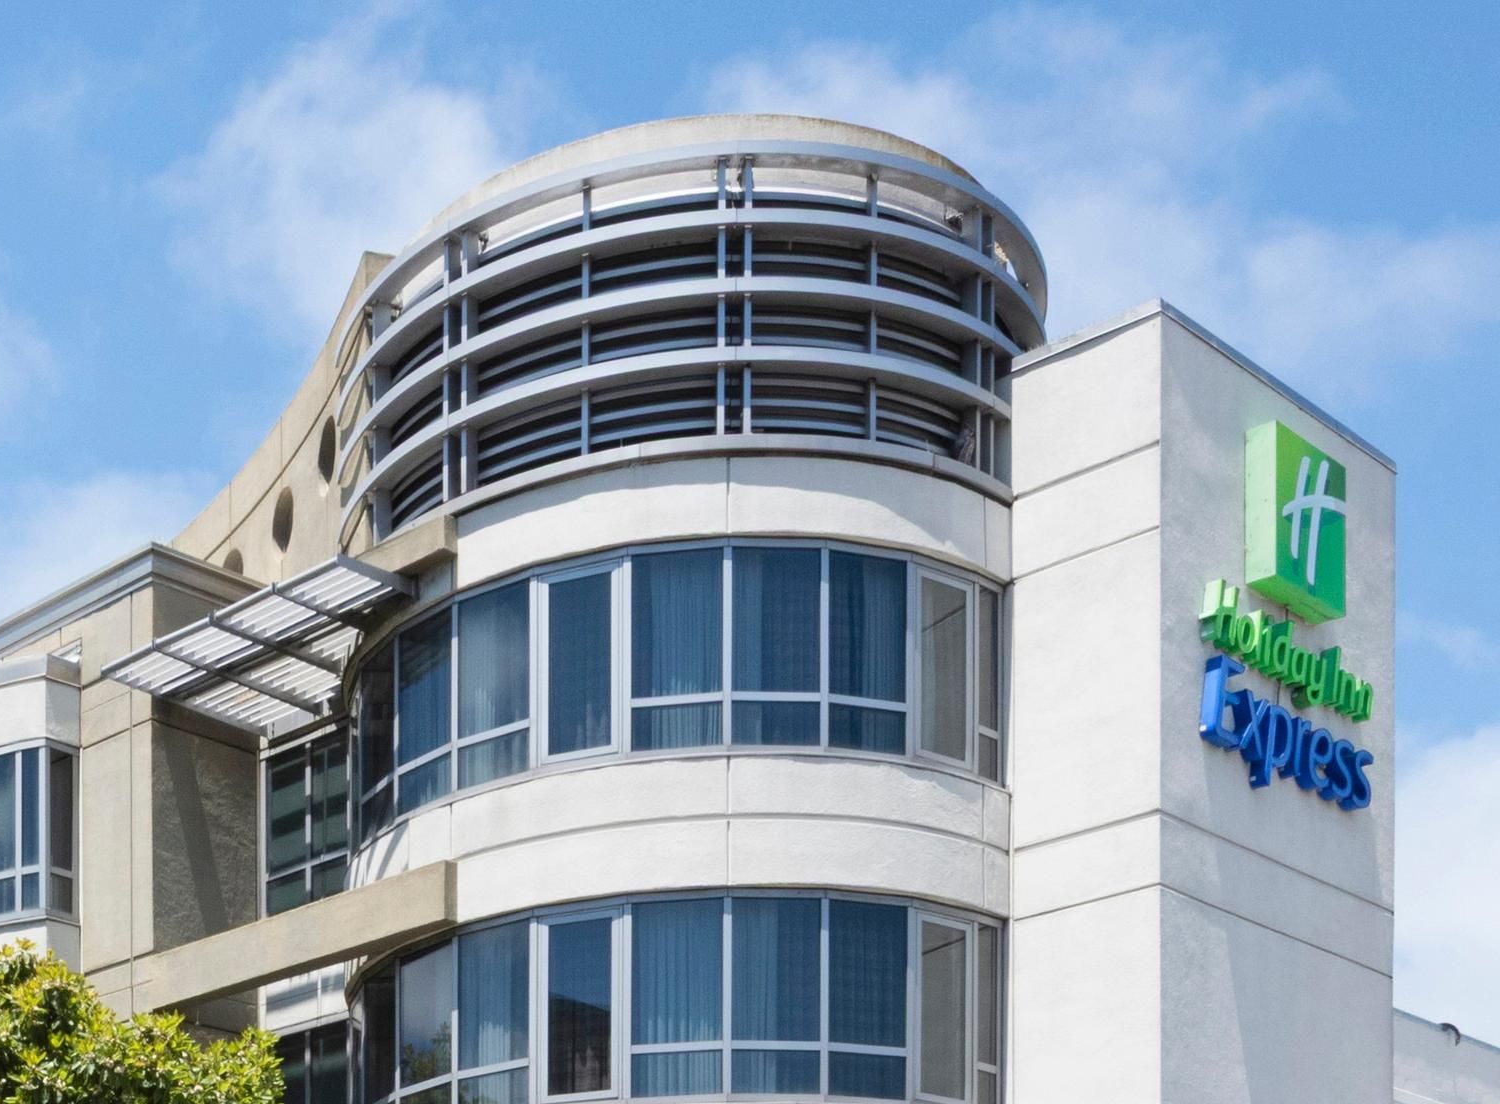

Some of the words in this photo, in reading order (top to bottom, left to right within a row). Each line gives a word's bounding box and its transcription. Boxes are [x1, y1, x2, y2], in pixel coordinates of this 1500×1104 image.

[1199, 578, 1327, 709] Holiday
[1322, 646, 1374, 722] Inn
[1199, 655, 1374, 811] Express
